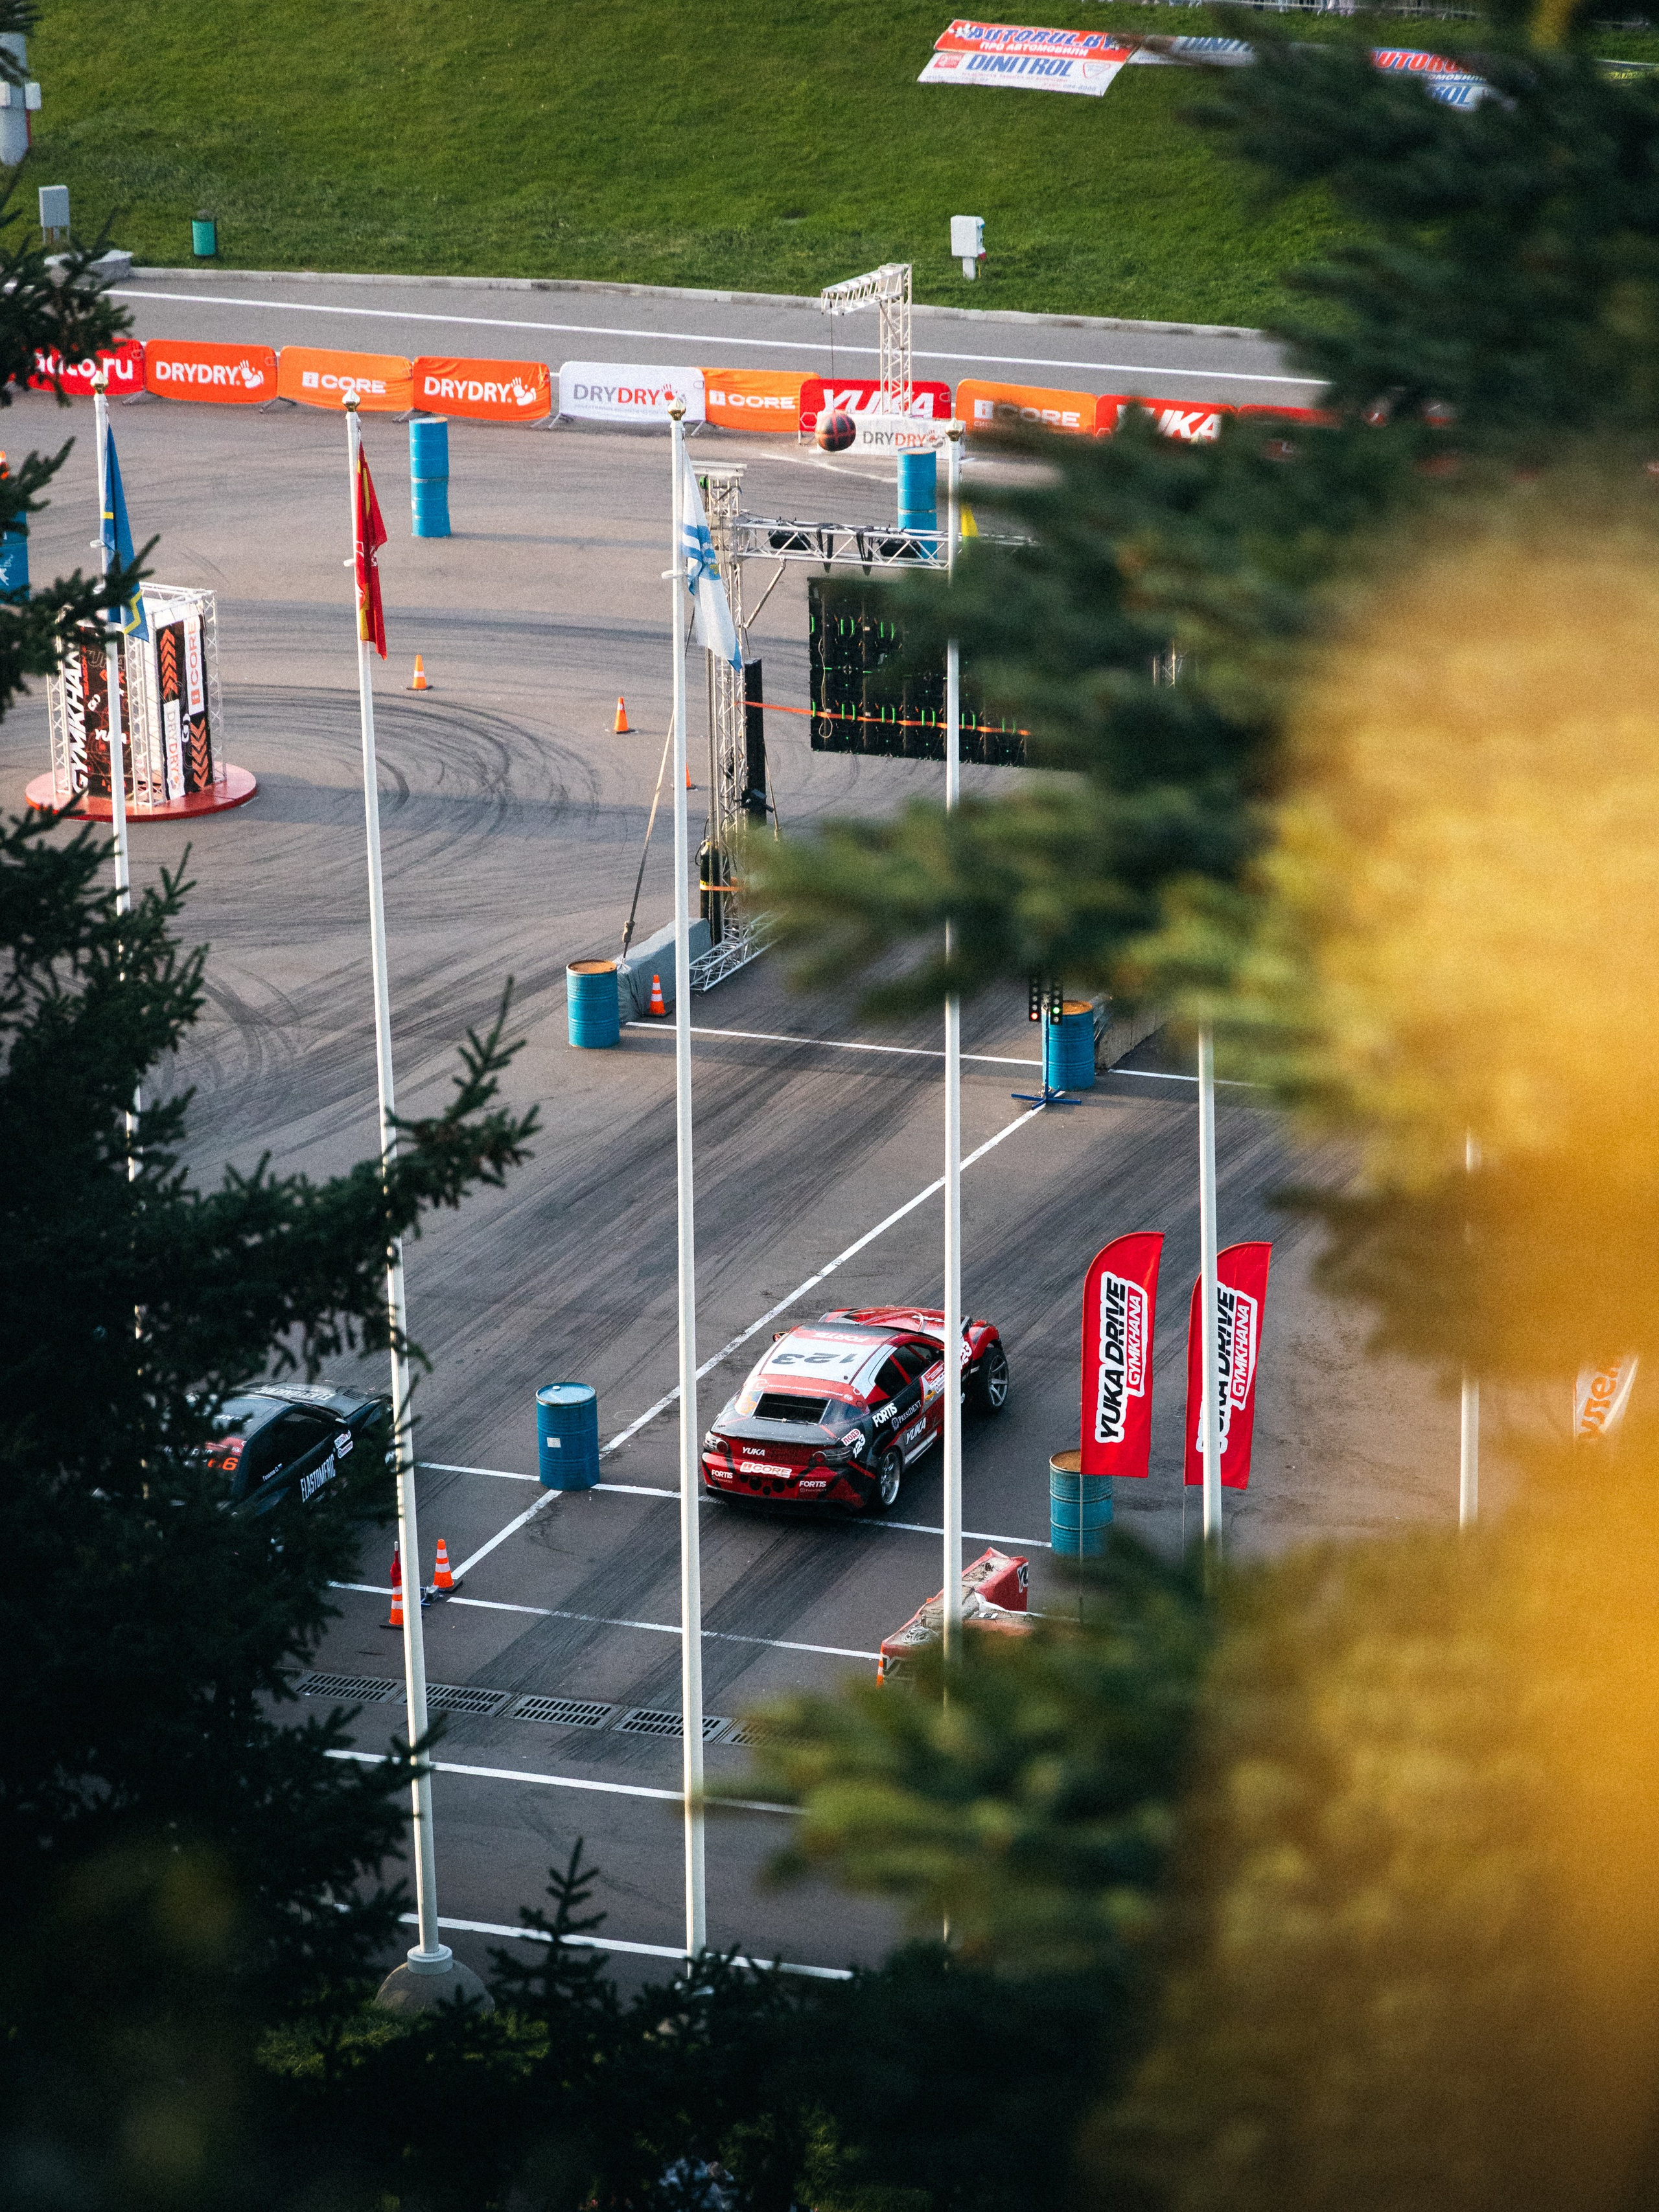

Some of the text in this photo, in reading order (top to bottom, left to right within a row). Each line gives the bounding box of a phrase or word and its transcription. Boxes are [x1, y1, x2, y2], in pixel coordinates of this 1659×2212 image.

[979, 41, 1089, 57] ПРО АВТОМОБИЛИ
[966, 54, 1075, 77] DINITROL
[156, 360, 240, 385] DRYDRY
[423, 377, 512, 403] DRYDRY
[574, 383, 660, 406] DRYDRY
[863, 431, 928, 447] DRYDRY
[1127, 1295, 1141, 1386] GYMKHANA
[1232, 1304, 1249, 1397] GYMKHANA
[771, 1352, 858, 1365] 123
[1100, 1277, 1126, 1438] YUKA DRIVE
[872, 1403, 898, 1428] FORTIS
[906, 1417, 927, 1445] YUKA
[742, 1447, 765, 1456] YUKA
[852, 1434, 866, 1459] 123
[300, 1453, 336, 1504] ELASTOMERIC
[712, 1469, 734, 1479] FORTIS
